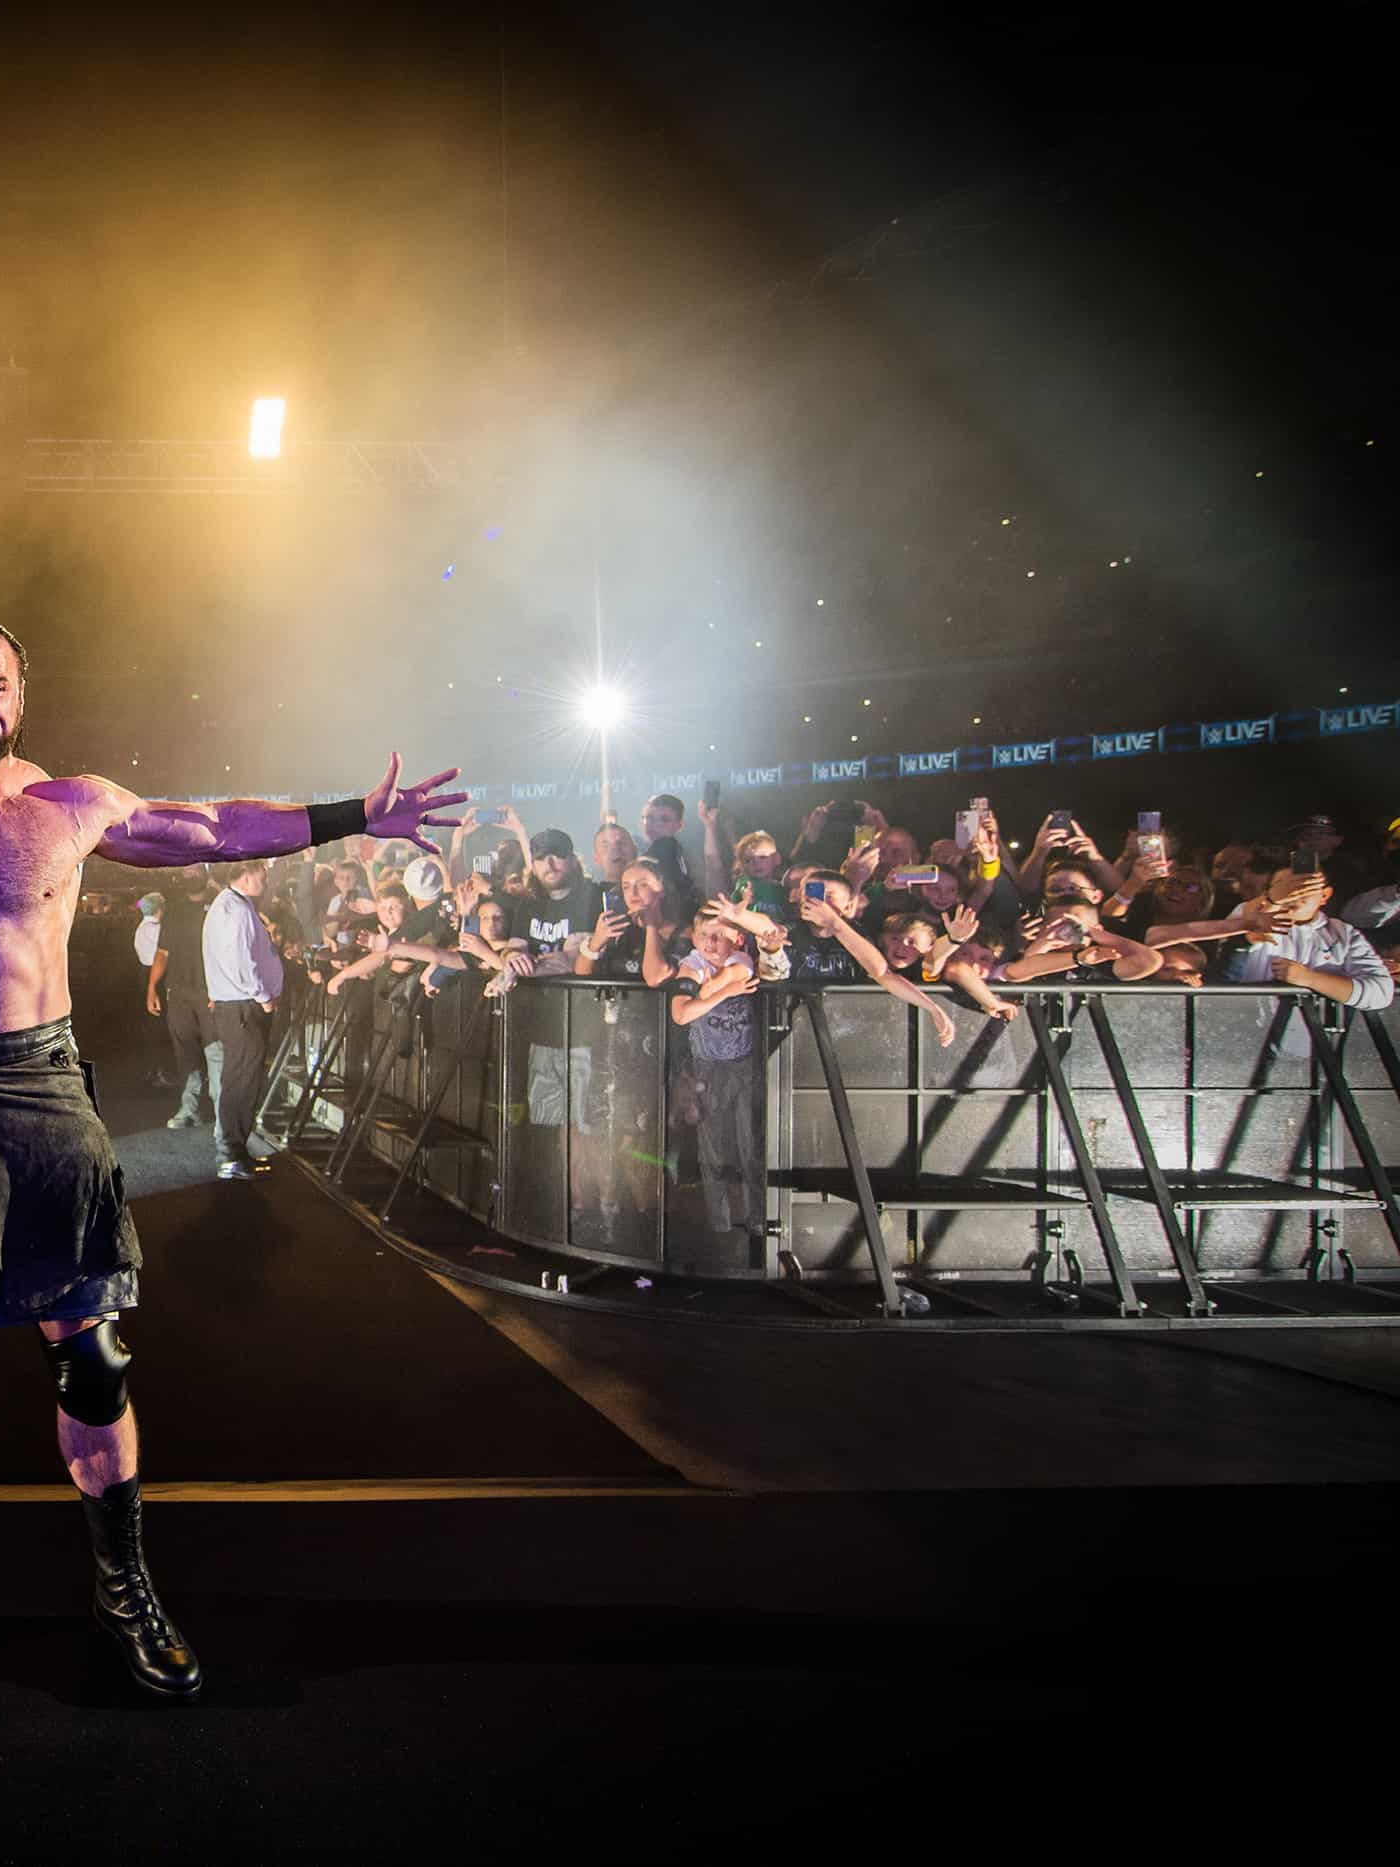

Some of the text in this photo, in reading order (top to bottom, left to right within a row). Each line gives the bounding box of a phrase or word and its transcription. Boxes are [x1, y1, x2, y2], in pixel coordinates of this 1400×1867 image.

[1347, 705, 1395, 727] LIVE
[1225, 720, 1268, 741] LIVE
[1116, 732, 1155, 752] LIVE
[920, 752, 953, 770] LIVE
[1014, 743, 1050, 762] LIVE
[747, 769, 777, 783] LIVE
[831, 762, 862, 776] LIVE
